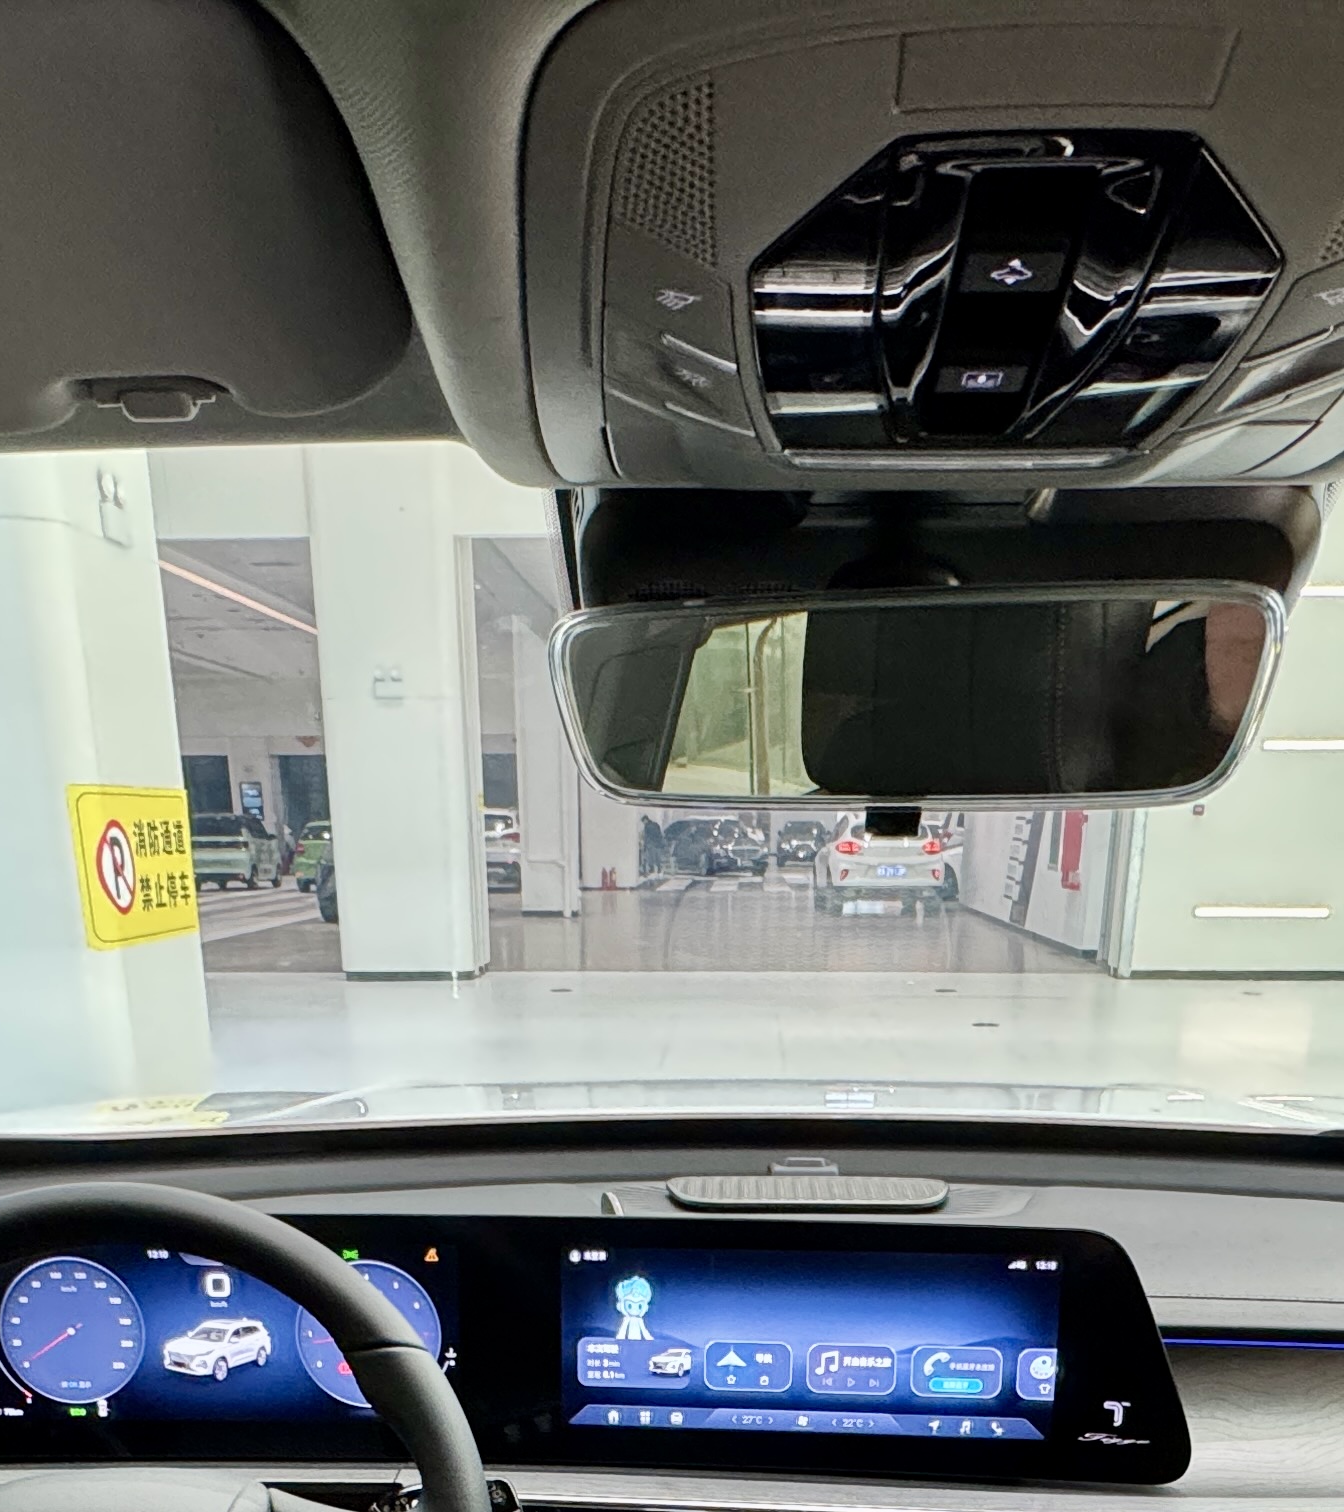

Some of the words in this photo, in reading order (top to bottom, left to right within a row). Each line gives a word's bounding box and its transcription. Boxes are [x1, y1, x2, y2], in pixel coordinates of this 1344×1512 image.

[133, 819, 186, 857] 消防通道
[140, 871, 191, 912] 禁止停车
